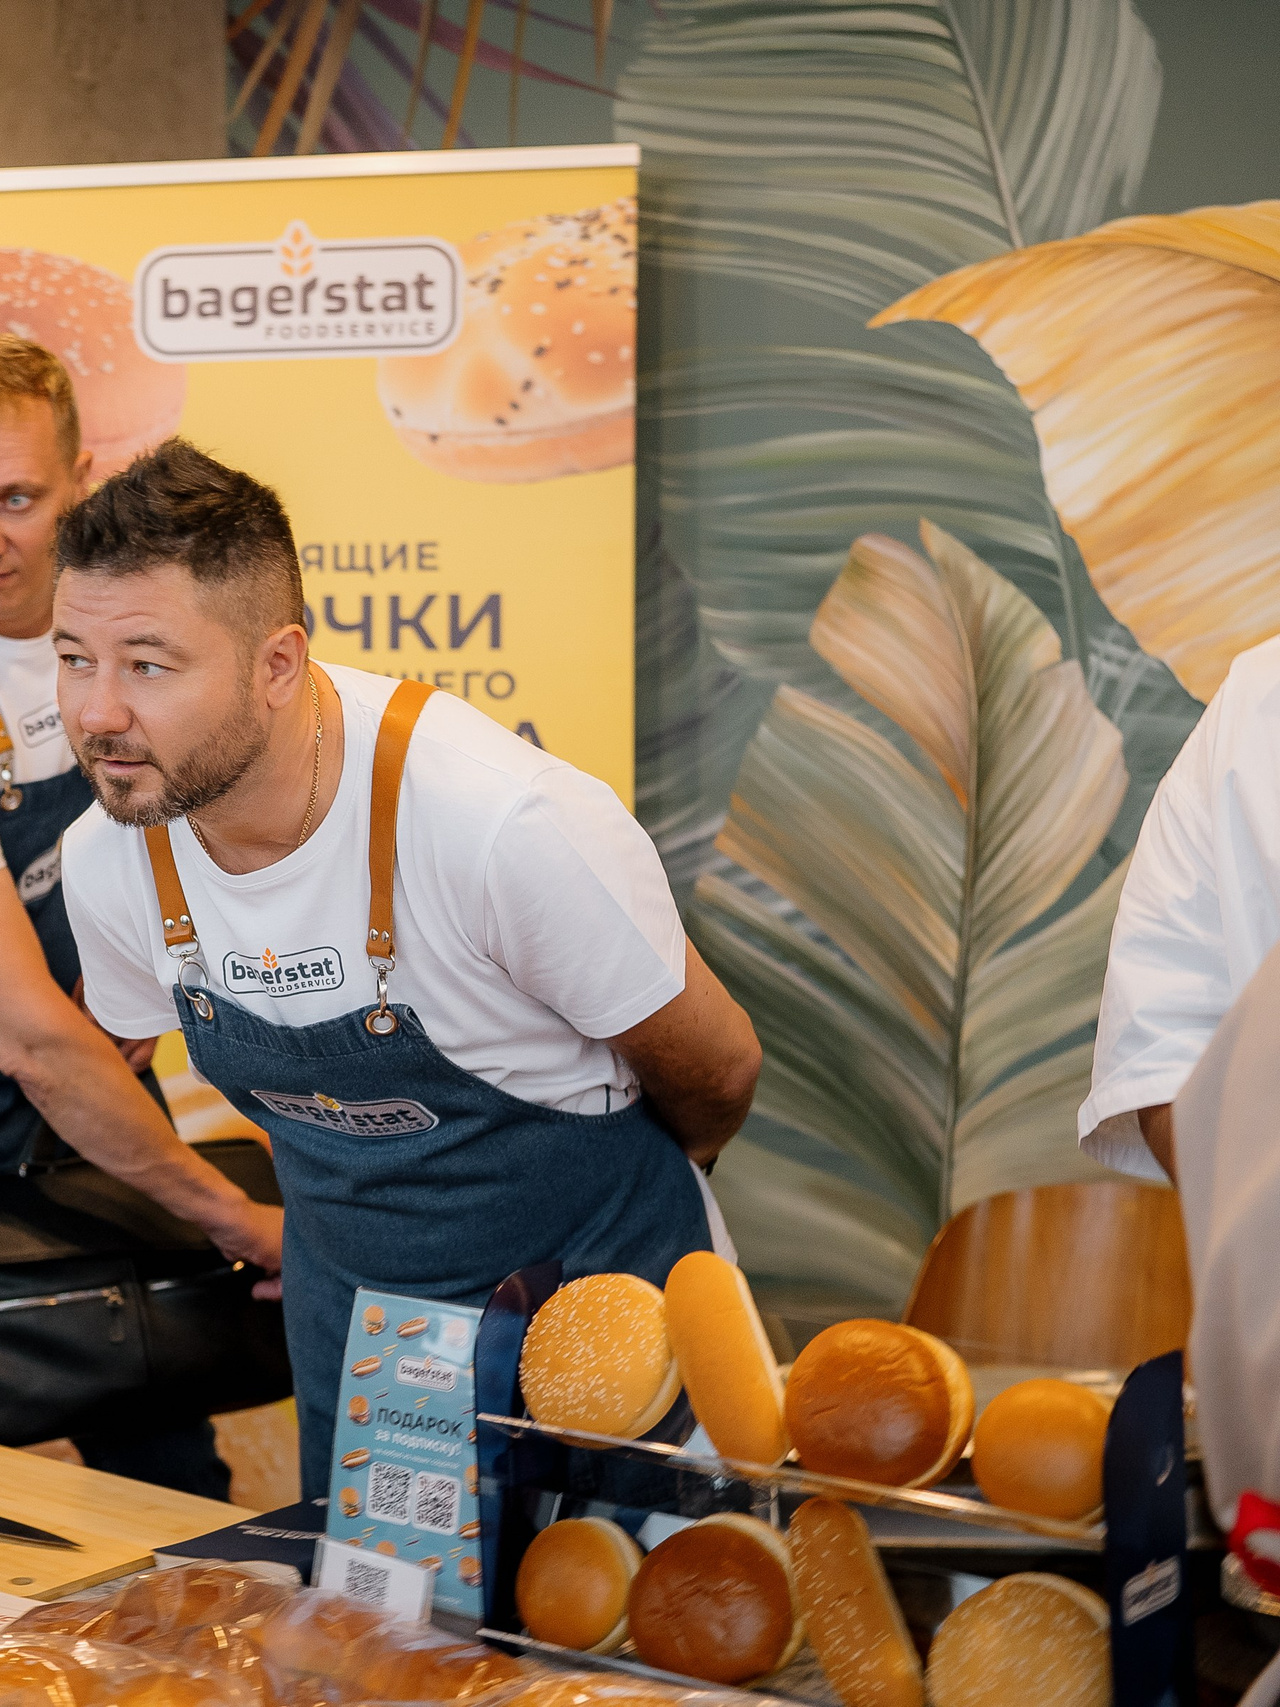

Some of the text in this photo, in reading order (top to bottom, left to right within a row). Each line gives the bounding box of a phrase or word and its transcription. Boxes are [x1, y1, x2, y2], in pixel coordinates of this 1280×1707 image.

[161, 272, 435, 328] bagerstat
[265, 321, 436, 340] FOODSERVICE
[300, 541, 439, 576] ЯЩИЕ
[266, 977, 337, 993] FOODSERVICE
[376, 1407, 464, 1438] ПОДАРОК
